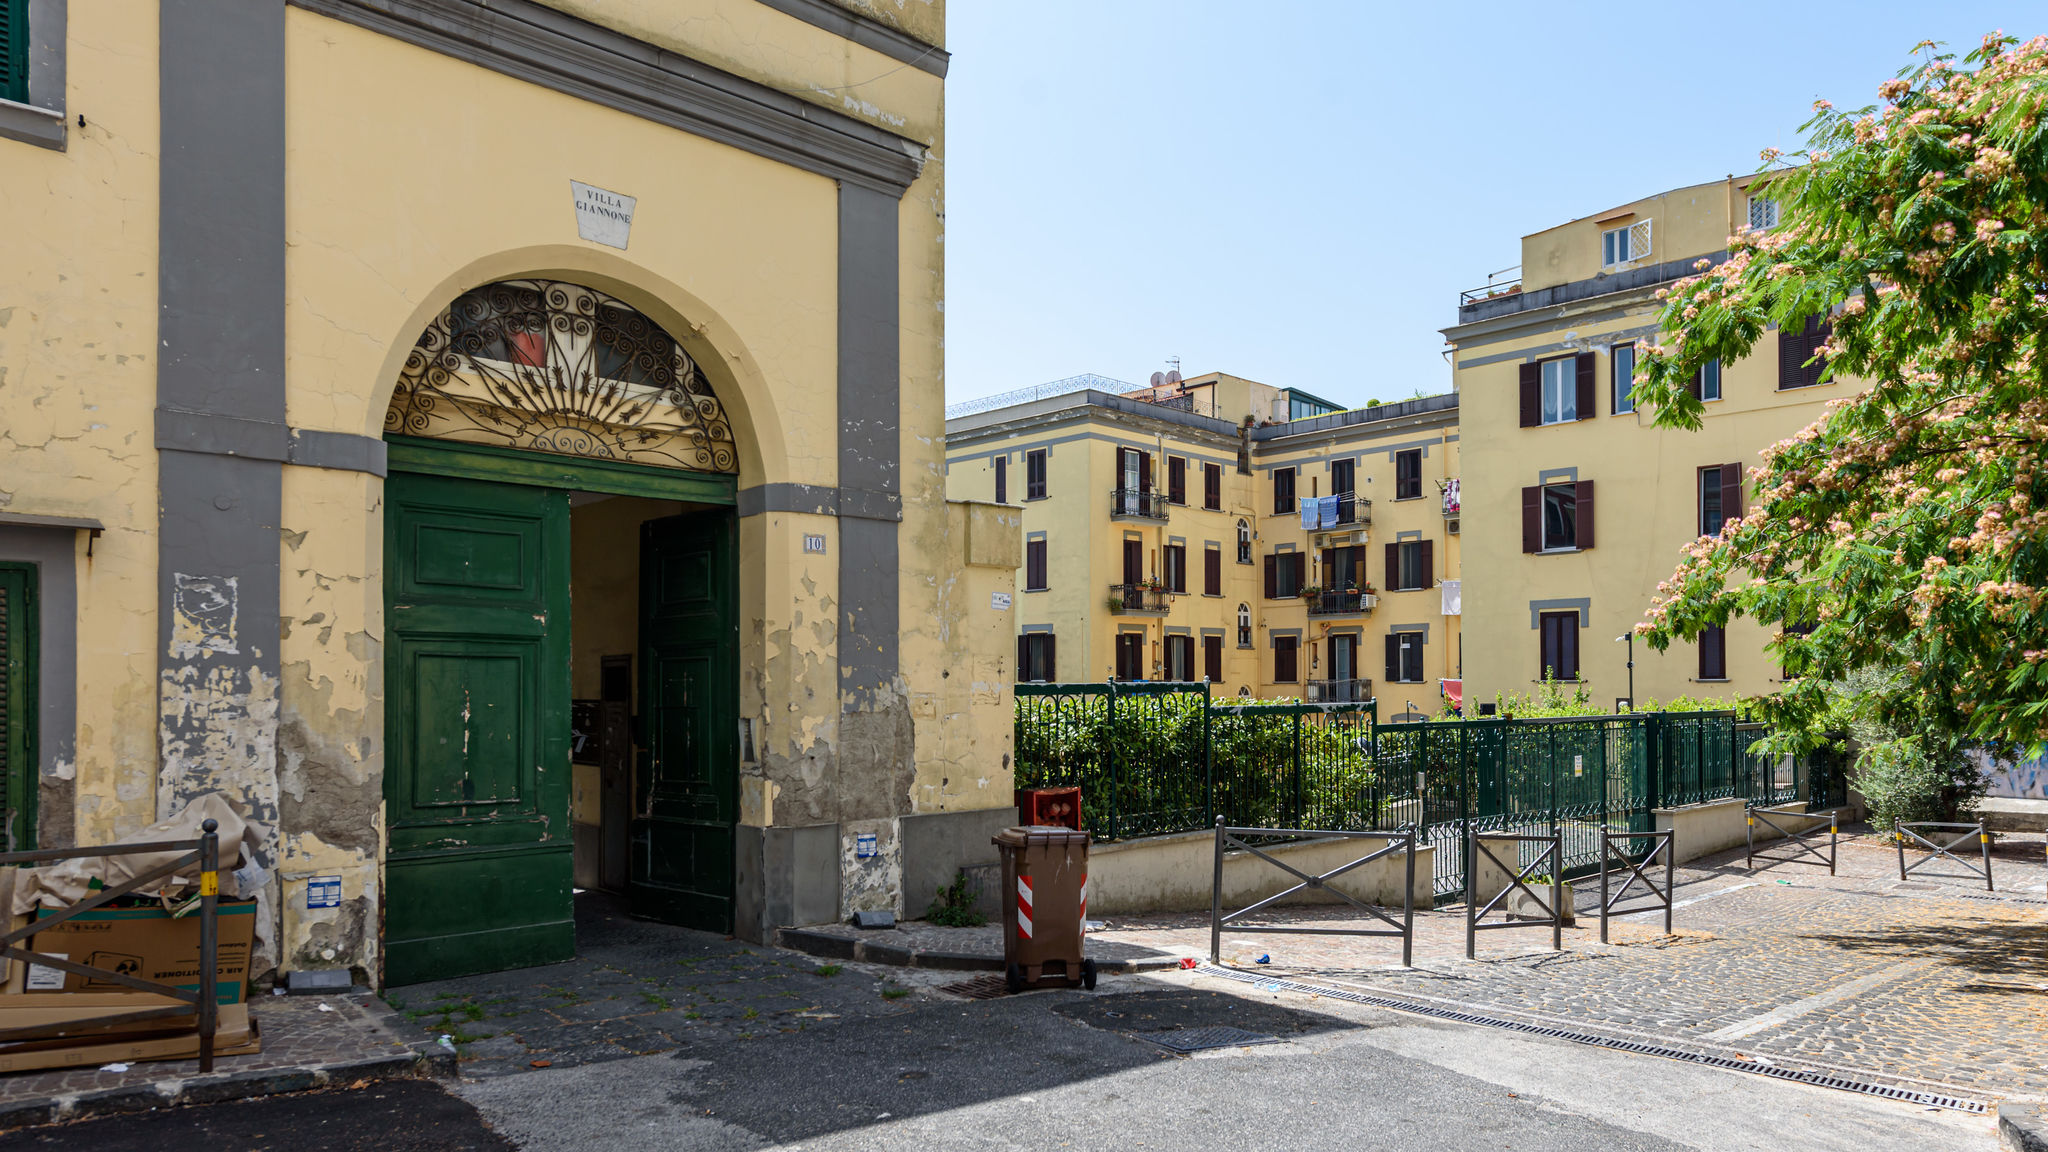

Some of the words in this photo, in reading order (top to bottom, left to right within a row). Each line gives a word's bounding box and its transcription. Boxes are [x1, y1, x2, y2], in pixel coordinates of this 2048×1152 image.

[587, 190, 621, 208] VILLA
[576, 200, 631, 224] GIANNONE
[809, 538, 820, 550] 10
